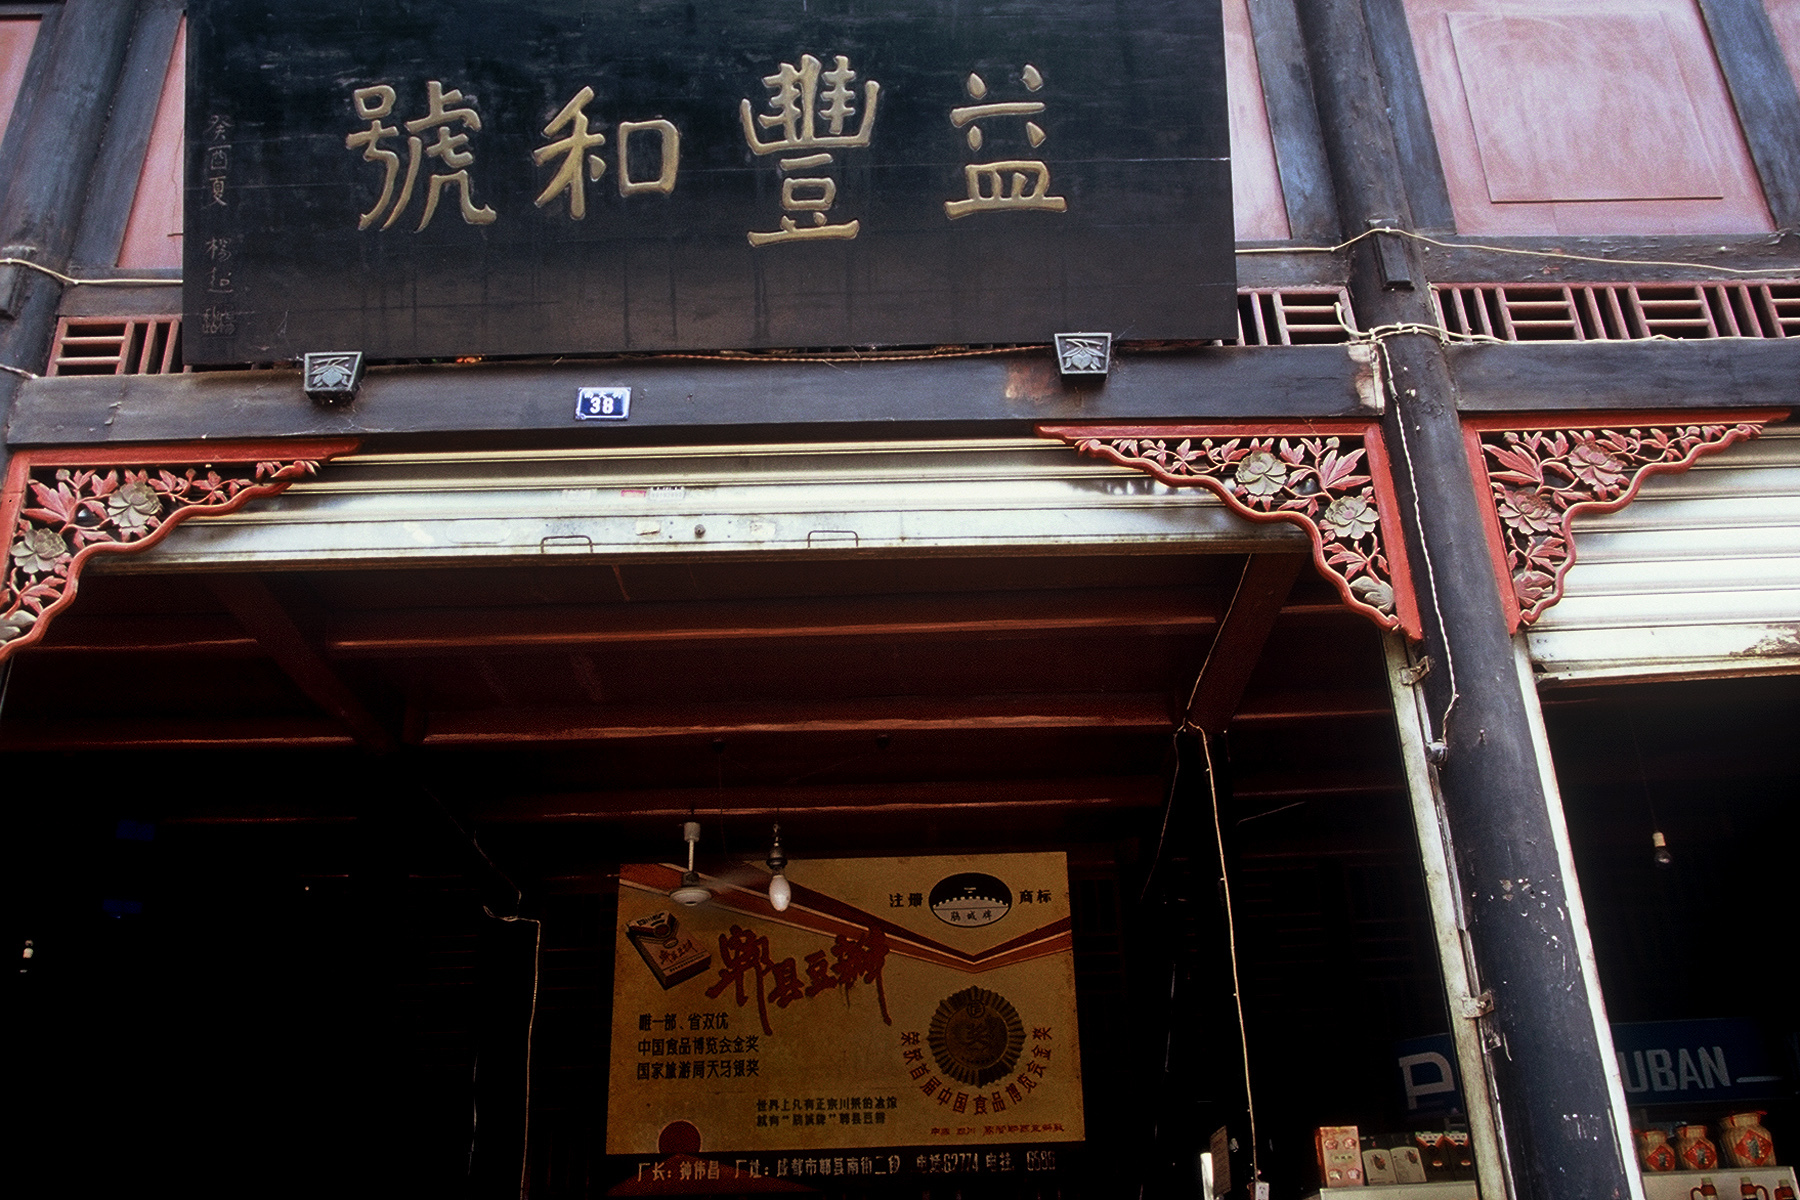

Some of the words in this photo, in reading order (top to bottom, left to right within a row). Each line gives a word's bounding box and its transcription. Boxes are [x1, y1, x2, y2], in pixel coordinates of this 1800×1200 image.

[589, 396, 614, 414] 38
[1018, 889, 1052, 905] 商标
[637, 1035, 759, 1056] 中国食品博览会金奖
[636, 1059, 759, 1081] 国家旅游局天马银奖
[901, 1027, 1053, 1115] 荣获首届中国食品博览会金奖
